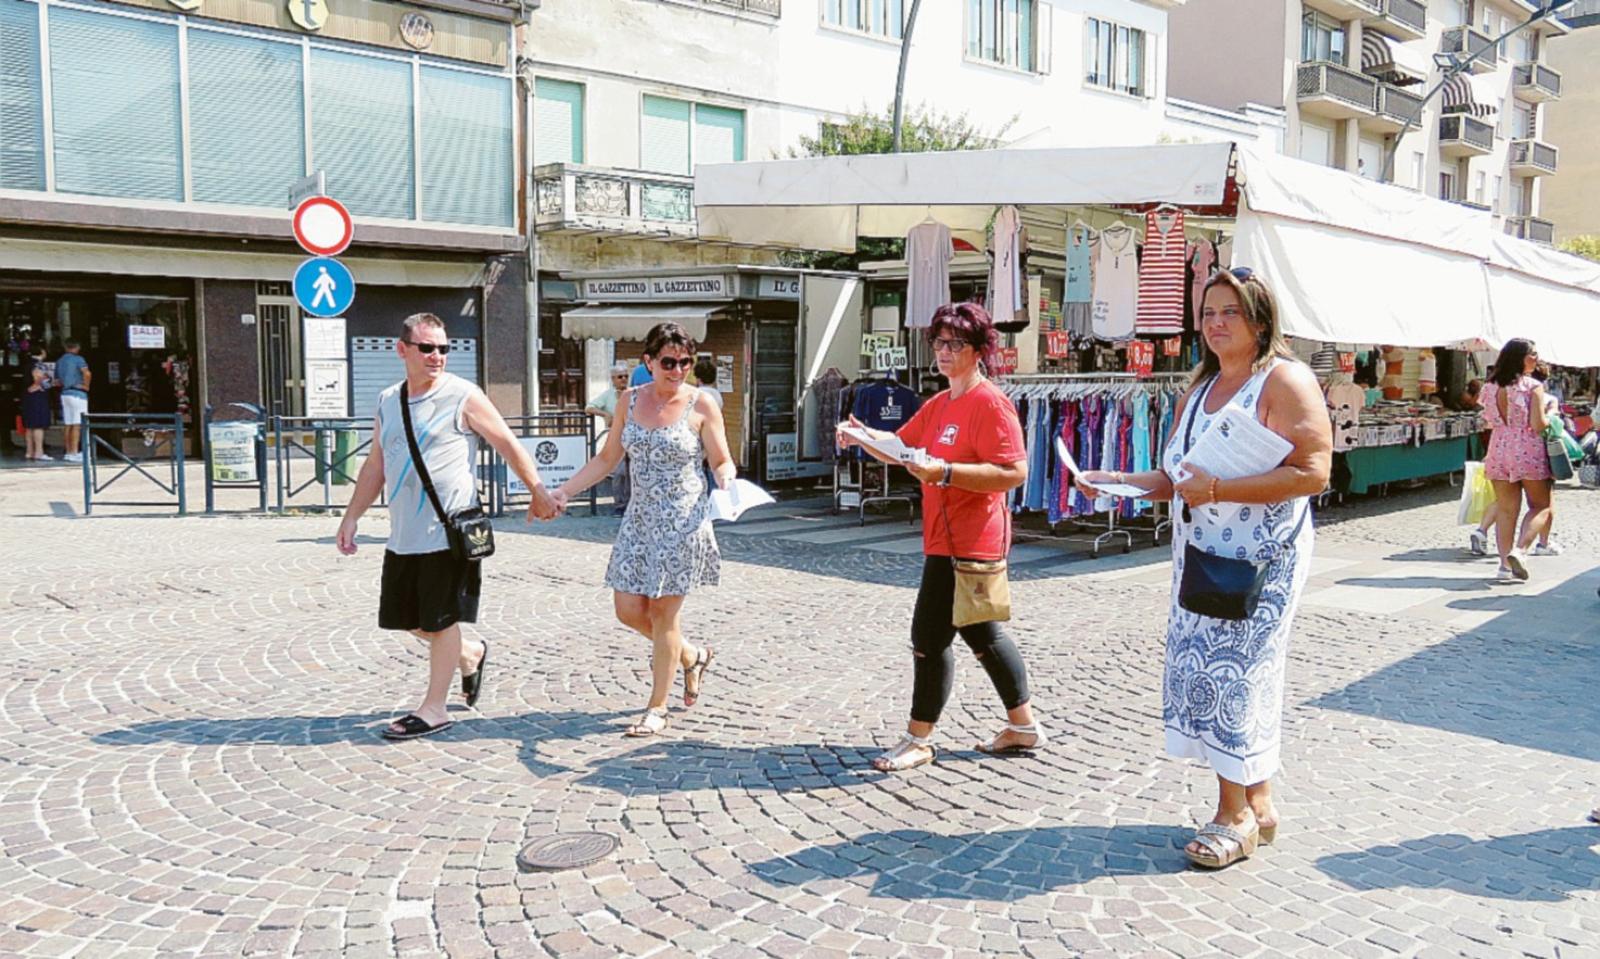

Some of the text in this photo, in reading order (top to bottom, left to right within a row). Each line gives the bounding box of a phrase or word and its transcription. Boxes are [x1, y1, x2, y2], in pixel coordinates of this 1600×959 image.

[589, 282, 647, 294] IL GAZZETTINO
[654, 282, 664, 293] IL
[665, 279, 721, 293] GAZZETTINO
[774, 280, 799, 293] IL G
[132, 327, 163, 336] SALDI
